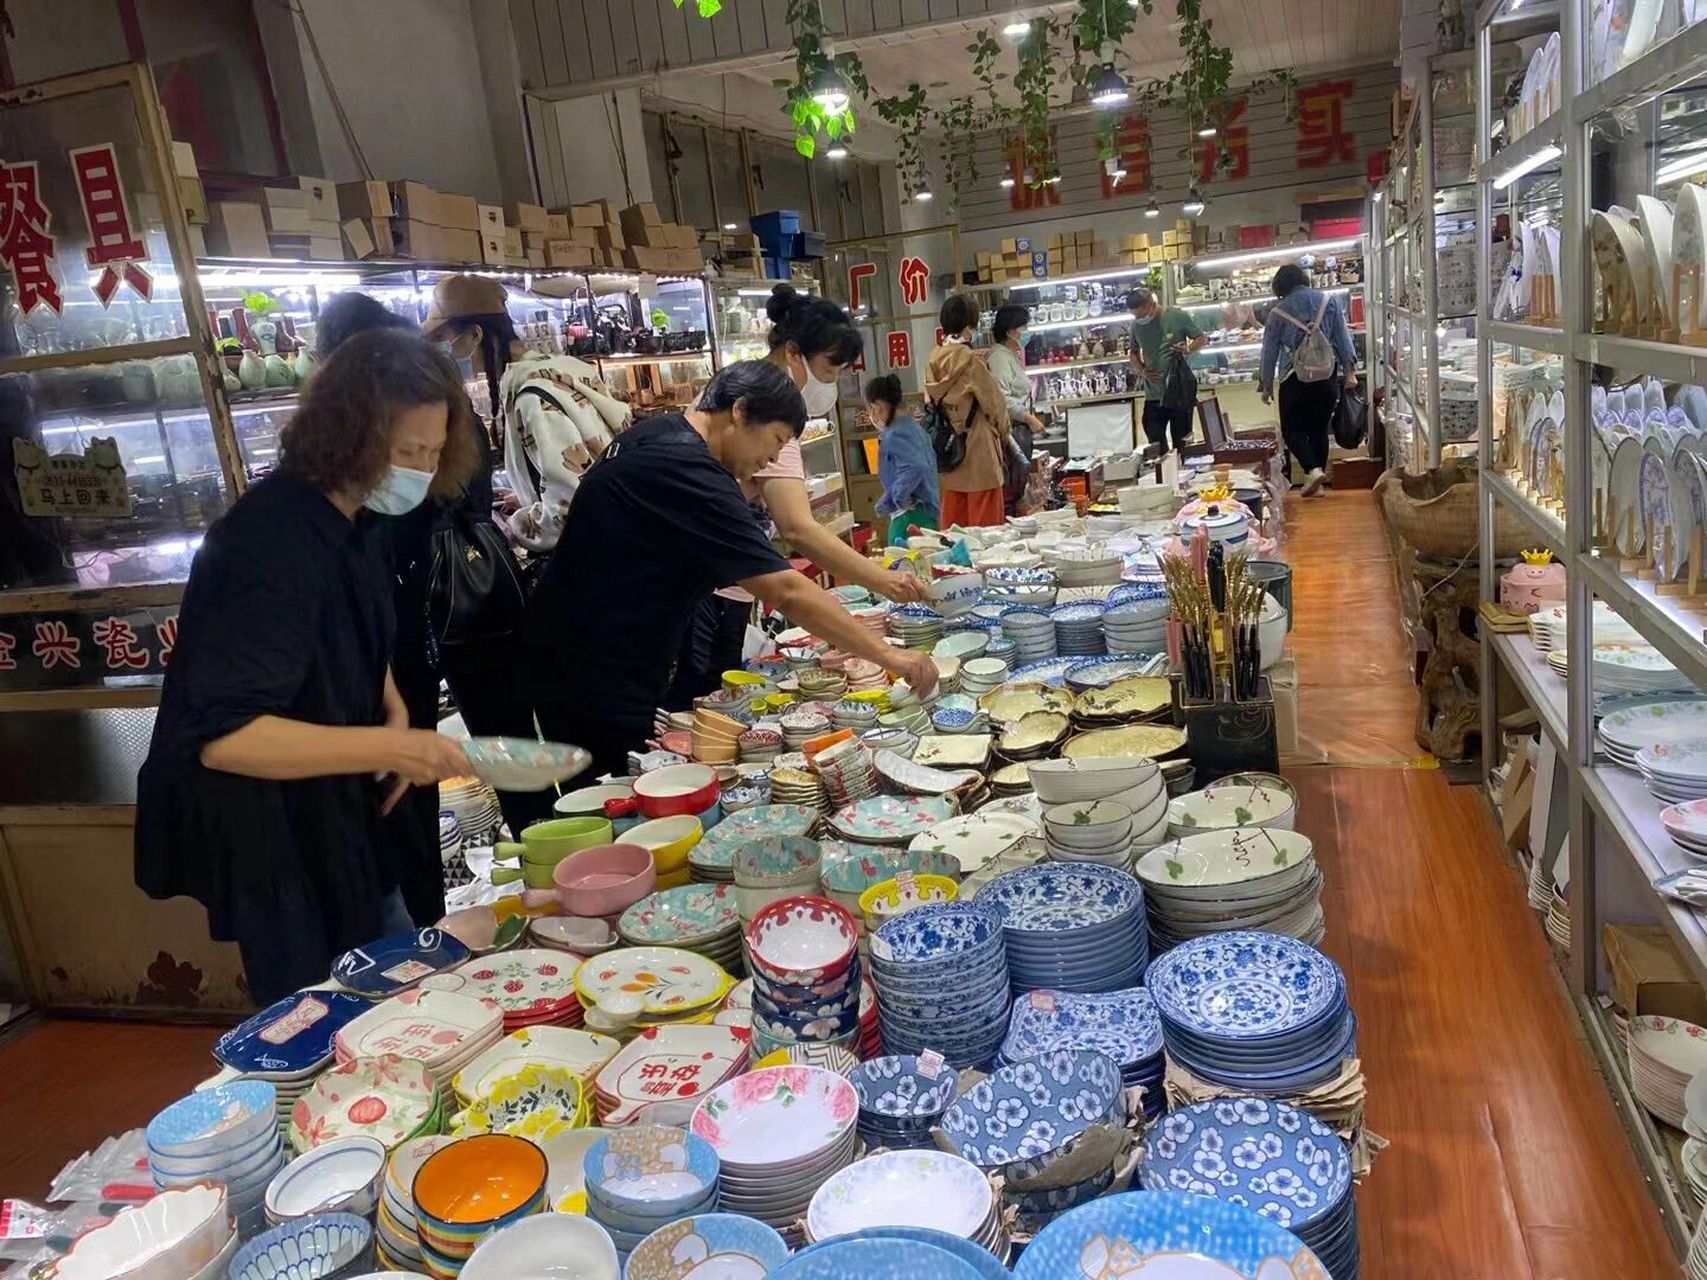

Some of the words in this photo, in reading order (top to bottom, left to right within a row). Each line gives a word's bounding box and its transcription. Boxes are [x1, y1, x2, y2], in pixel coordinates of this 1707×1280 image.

[0, 142, 153, 320] 餐具
[849, 256, 930, 312] 厂价
[41, 487, 112, 506] 马上回来
